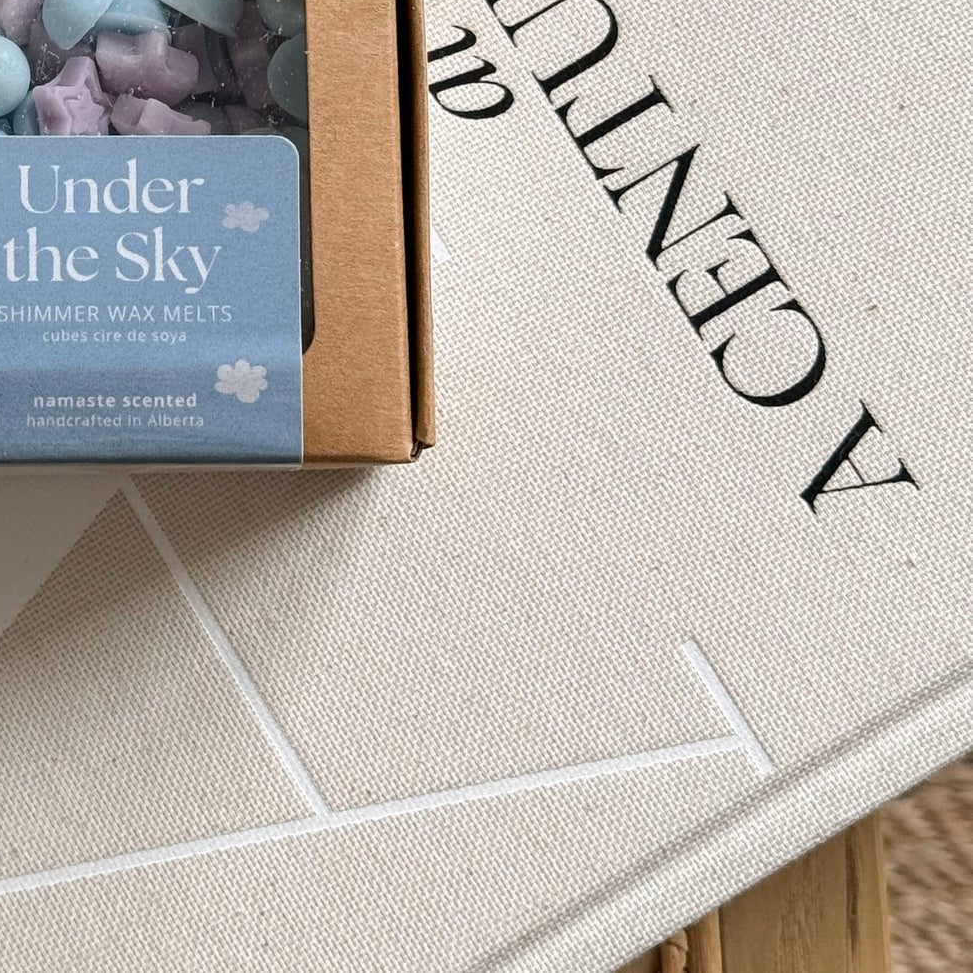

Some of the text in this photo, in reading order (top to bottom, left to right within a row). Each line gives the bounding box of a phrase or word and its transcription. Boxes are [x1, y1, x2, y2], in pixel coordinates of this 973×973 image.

[17, 158, 206, 215] Under
[2, 226, 223, 295] the Sky
[107, 305, 155, 323] WAX
[163, 305, 233, 323] MELTS
[42, 328, 187, 345] cubes cire de soya
[33, 393, 198, 408] namaste scented
[26, 413, 205, 428] handcrafted in Alberta
[798, 400, 921, 515] A
